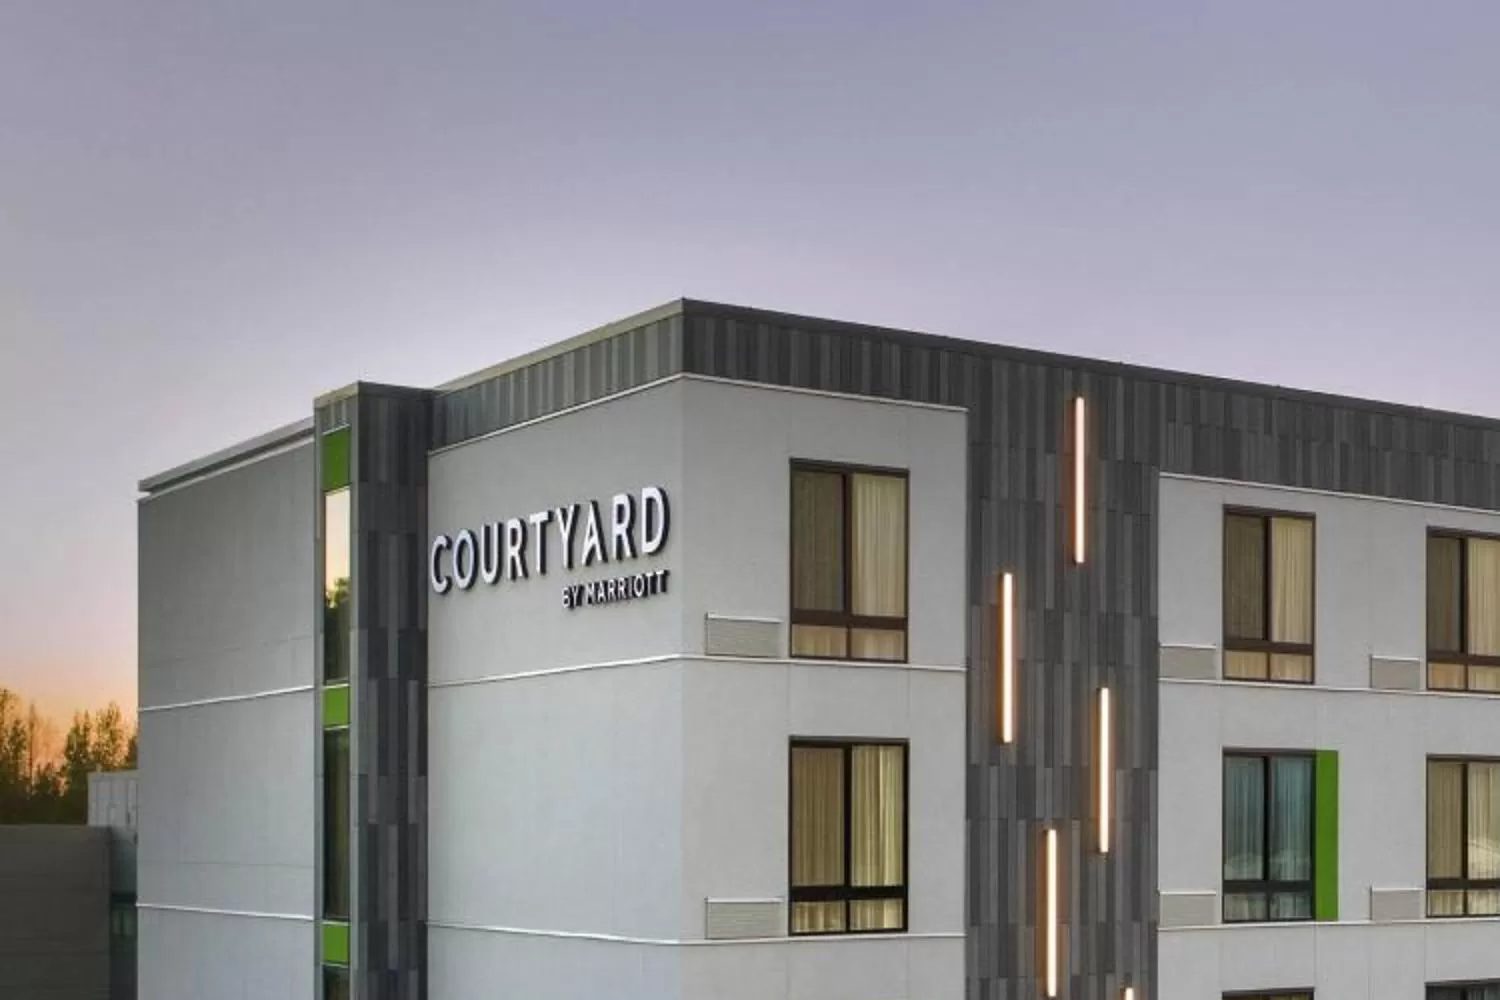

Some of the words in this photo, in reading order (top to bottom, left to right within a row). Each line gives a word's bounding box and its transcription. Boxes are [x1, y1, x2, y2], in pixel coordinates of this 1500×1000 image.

[431, 487, 669, 593] COURTYARD
[562, 583, 581, 609] BY
[586, 569, 668, 603] MARRIOTT
